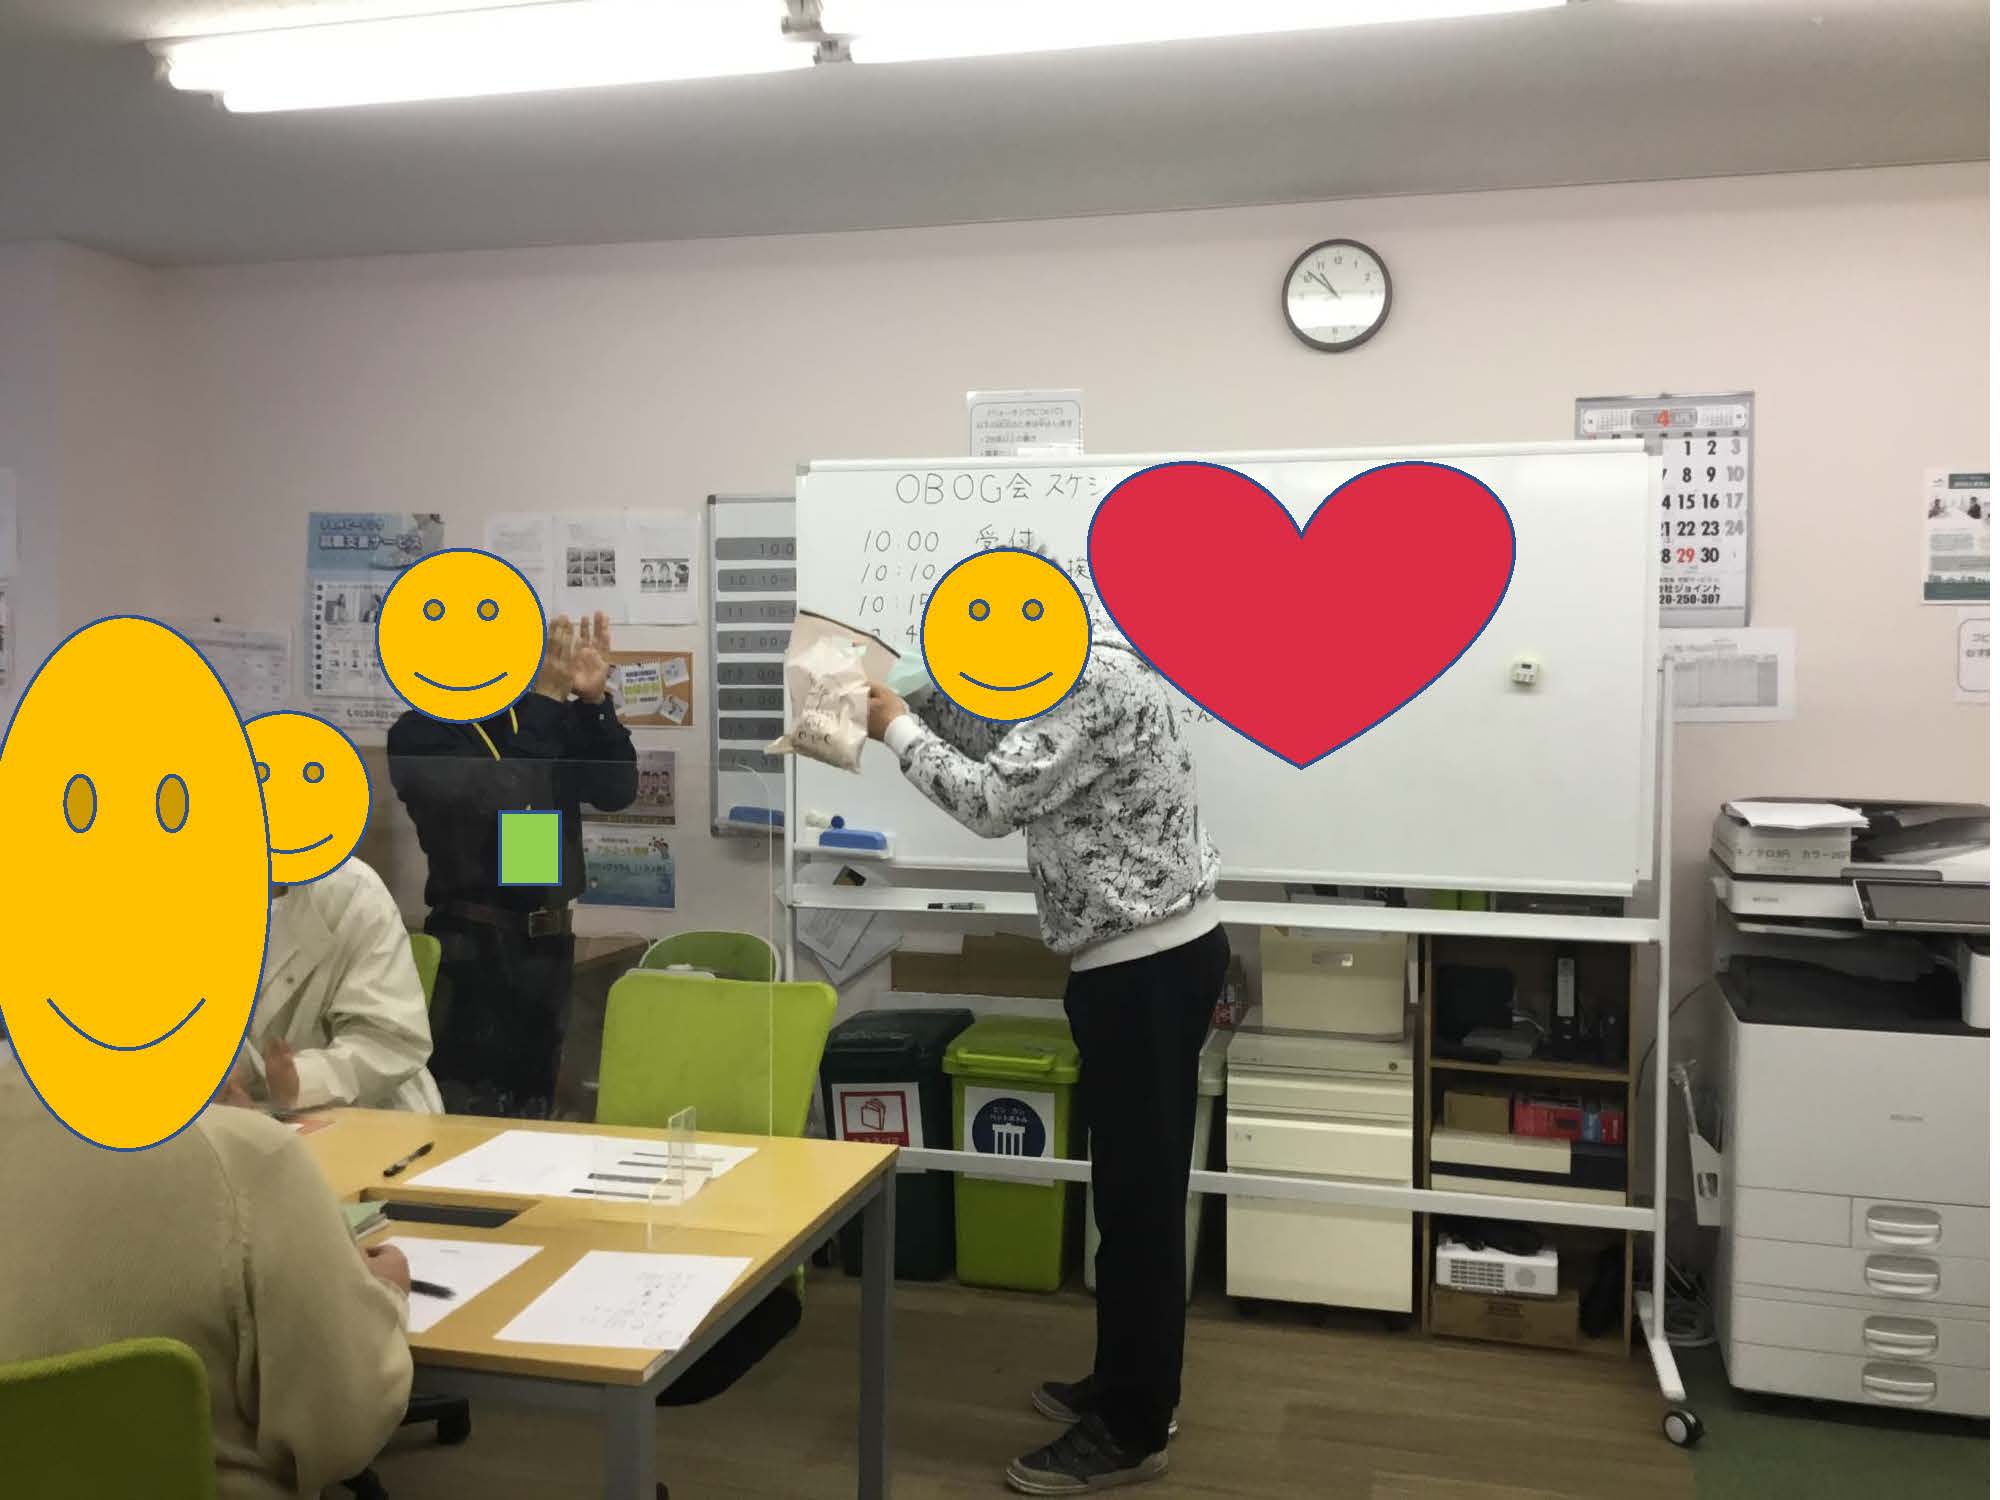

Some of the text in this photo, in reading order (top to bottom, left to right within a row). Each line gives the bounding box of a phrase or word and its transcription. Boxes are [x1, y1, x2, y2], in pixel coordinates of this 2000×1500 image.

[1656, 409, 1672, 428] 4
[1683, 438, 1742, 456] 1 2 3
[1682, 466, 1692, 483] 8
[1706, 466, 1716, 482] 9
[1726, 465, 1745, 482] 10
[1661, 492, 1744, 510] 4 15 16 17
[975, 523, 1034, 550] 受付
[1677, 520, 1696, 536] 22
[1701, 520, 1720, 536] 23
[1725, 519, 1744, 536] 24
[1661, 547, 1671, 564] 8
[1676, 547, 1696, 564] 29
[1699, 547, 1720, 563] 30
[860, 563, 936, 584] 10:10
